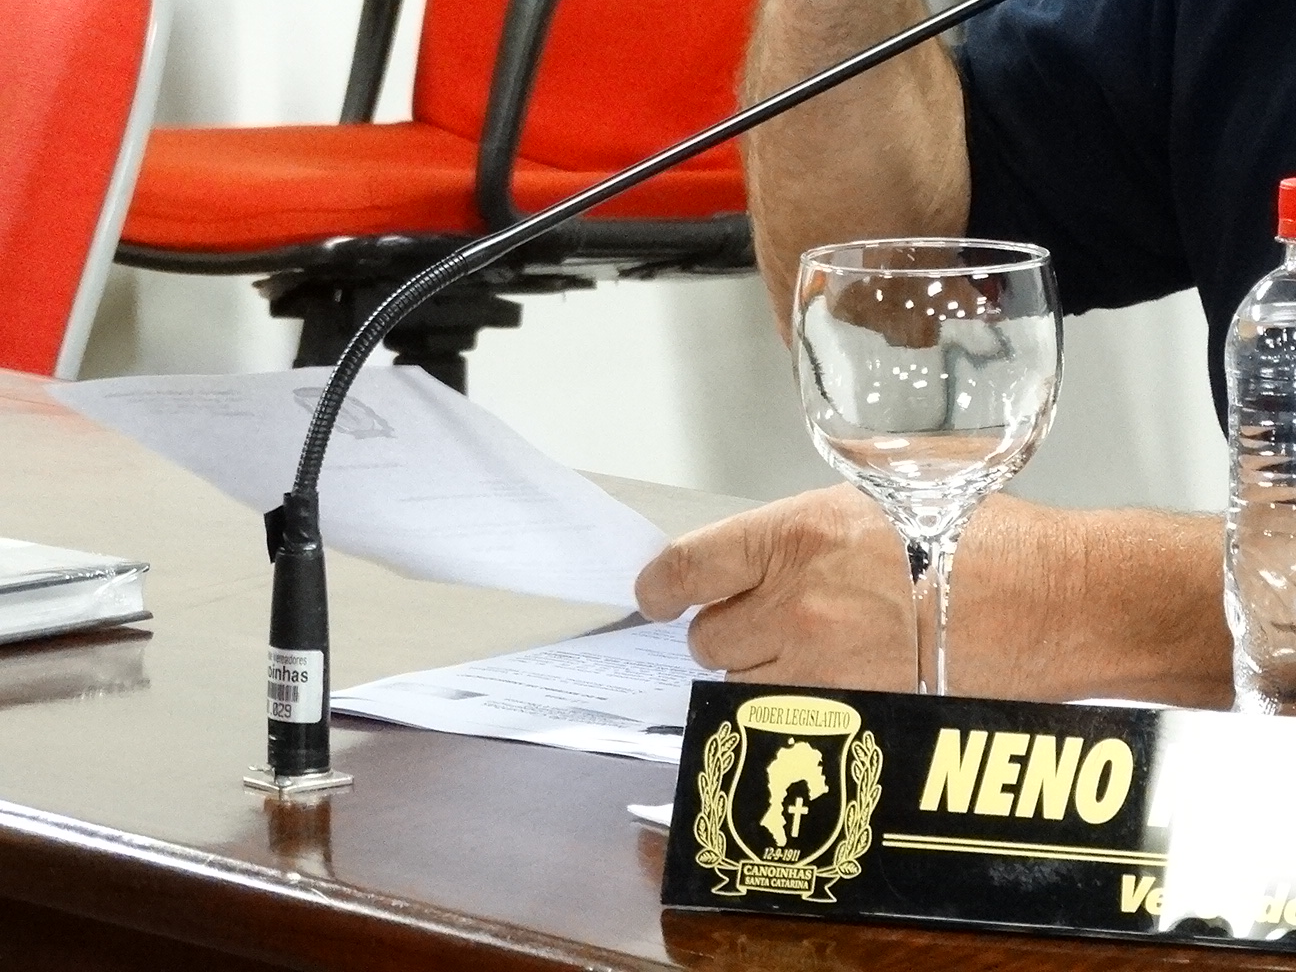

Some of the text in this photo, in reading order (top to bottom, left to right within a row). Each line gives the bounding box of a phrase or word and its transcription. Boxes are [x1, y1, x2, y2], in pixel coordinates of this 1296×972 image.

[748, 706, 851, 730] PODER LEGISLATIVO
[919, 728, 1134, 825] NENO
[762, 847, 801, 862] 12-9-1911
[743, 864, 813, 881] CANOINHAS
[744, 877, 810, 890] SANTA CATARINA
